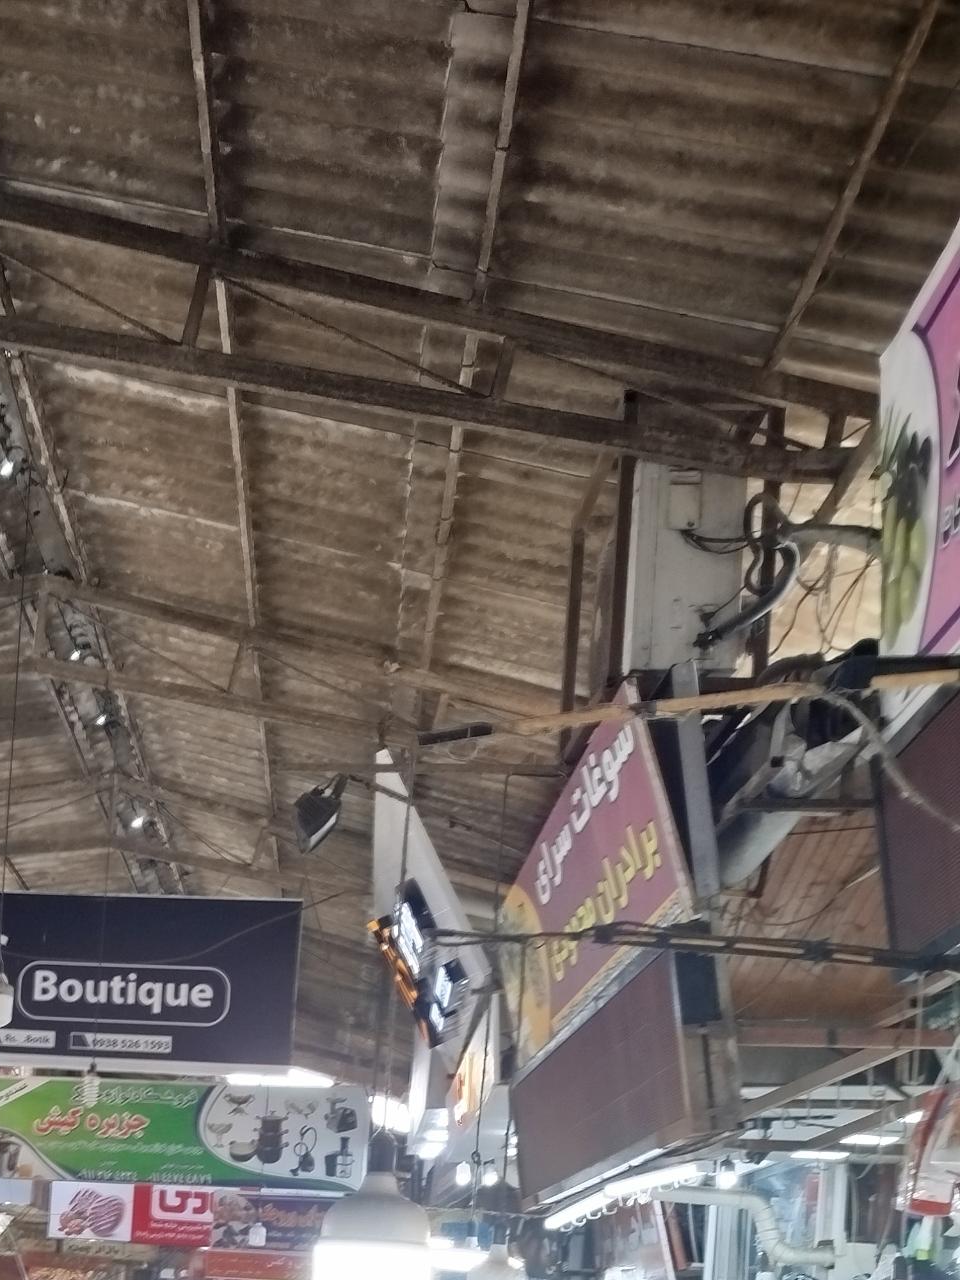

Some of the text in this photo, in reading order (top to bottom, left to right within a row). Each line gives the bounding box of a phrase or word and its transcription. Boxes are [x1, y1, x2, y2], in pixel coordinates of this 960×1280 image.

[533, 722, 636, 907] سوغات سرای
[595, 818, 663, 925] برادران
[33, 971, 214, 1014] Boutique
[33, 1105, 150, 1138] جزیره کیش
